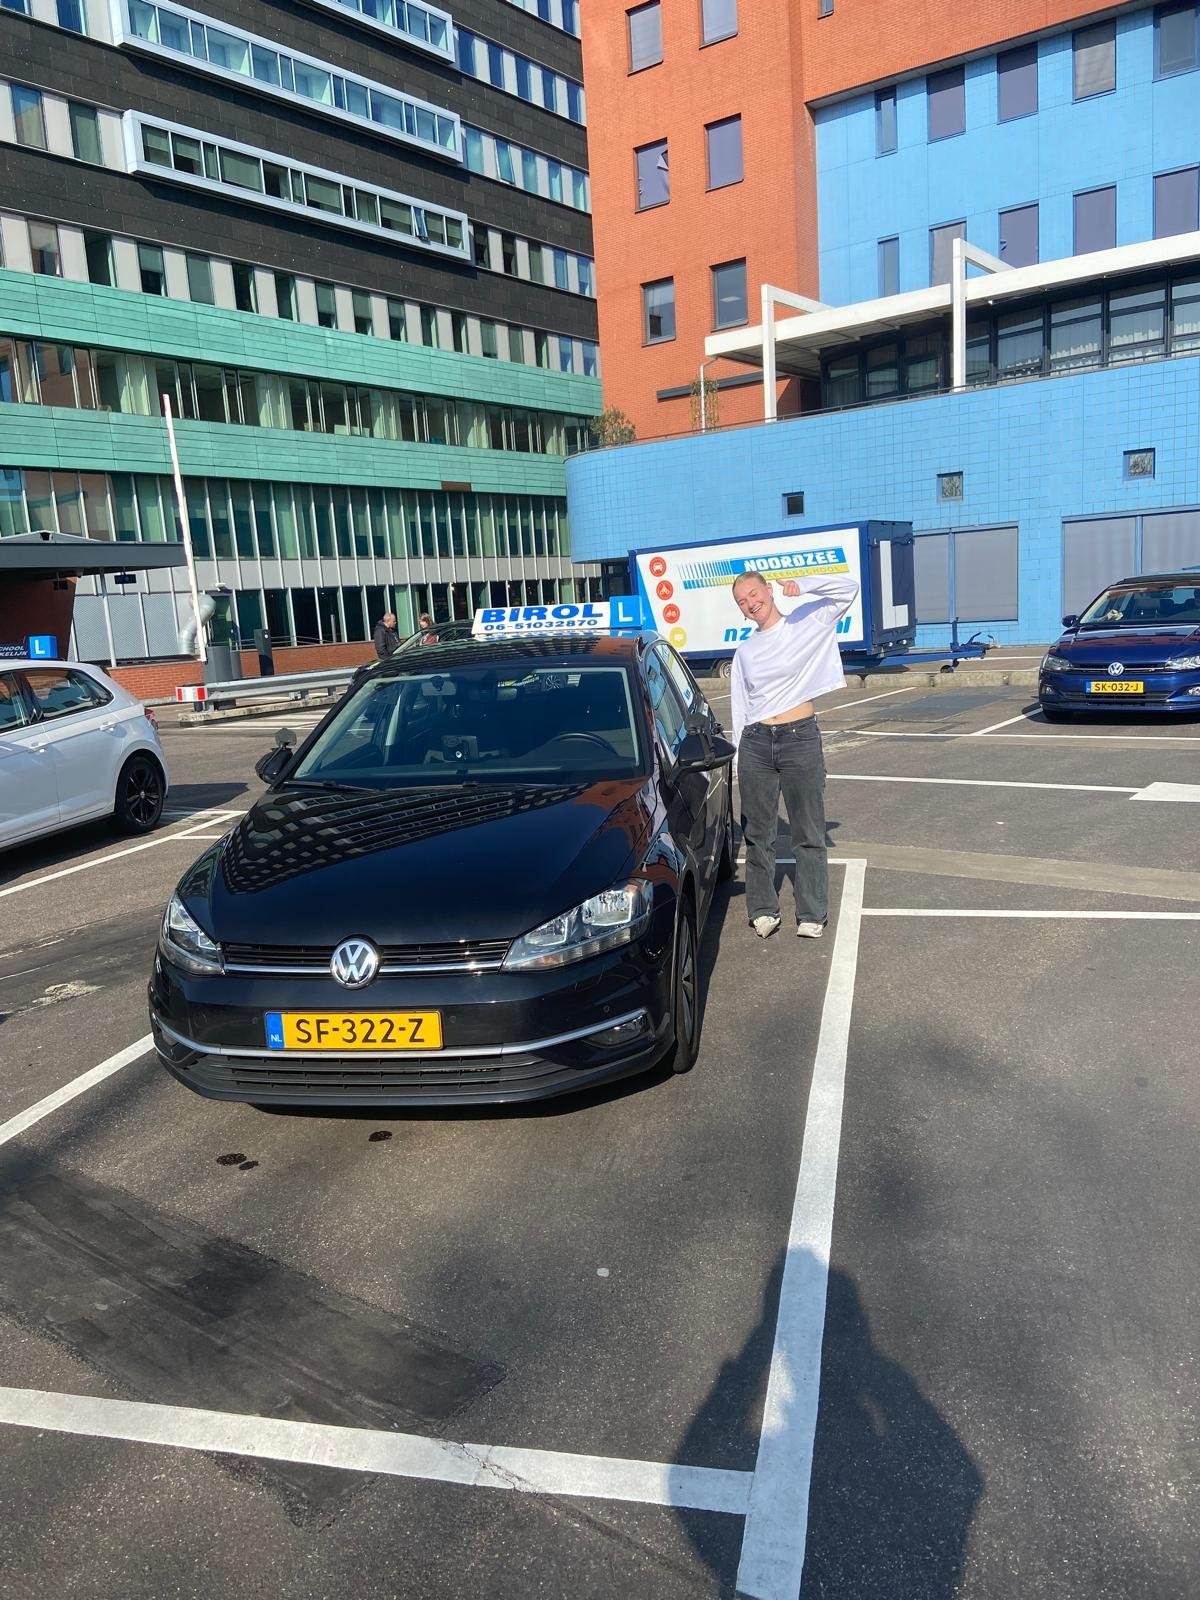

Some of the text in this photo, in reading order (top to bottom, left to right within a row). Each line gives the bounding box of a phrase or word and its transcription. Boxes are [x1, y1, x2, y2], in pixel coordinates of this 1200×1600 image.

[744, 550, 840, 572] NOORDZEE
[879, 540, 909, 630] L
[481, 604, 604, 624] BIROL
[618, 602, 634, 622] L
[484, 619, 598, 632] 06-51032870
[35, 640, 45, 654] L
[1094, 683, 1139, 692] SK-032-J
[271, 1034, 282, 1043] NL
[296, 1018, 425, 1044] SF-322-Z
